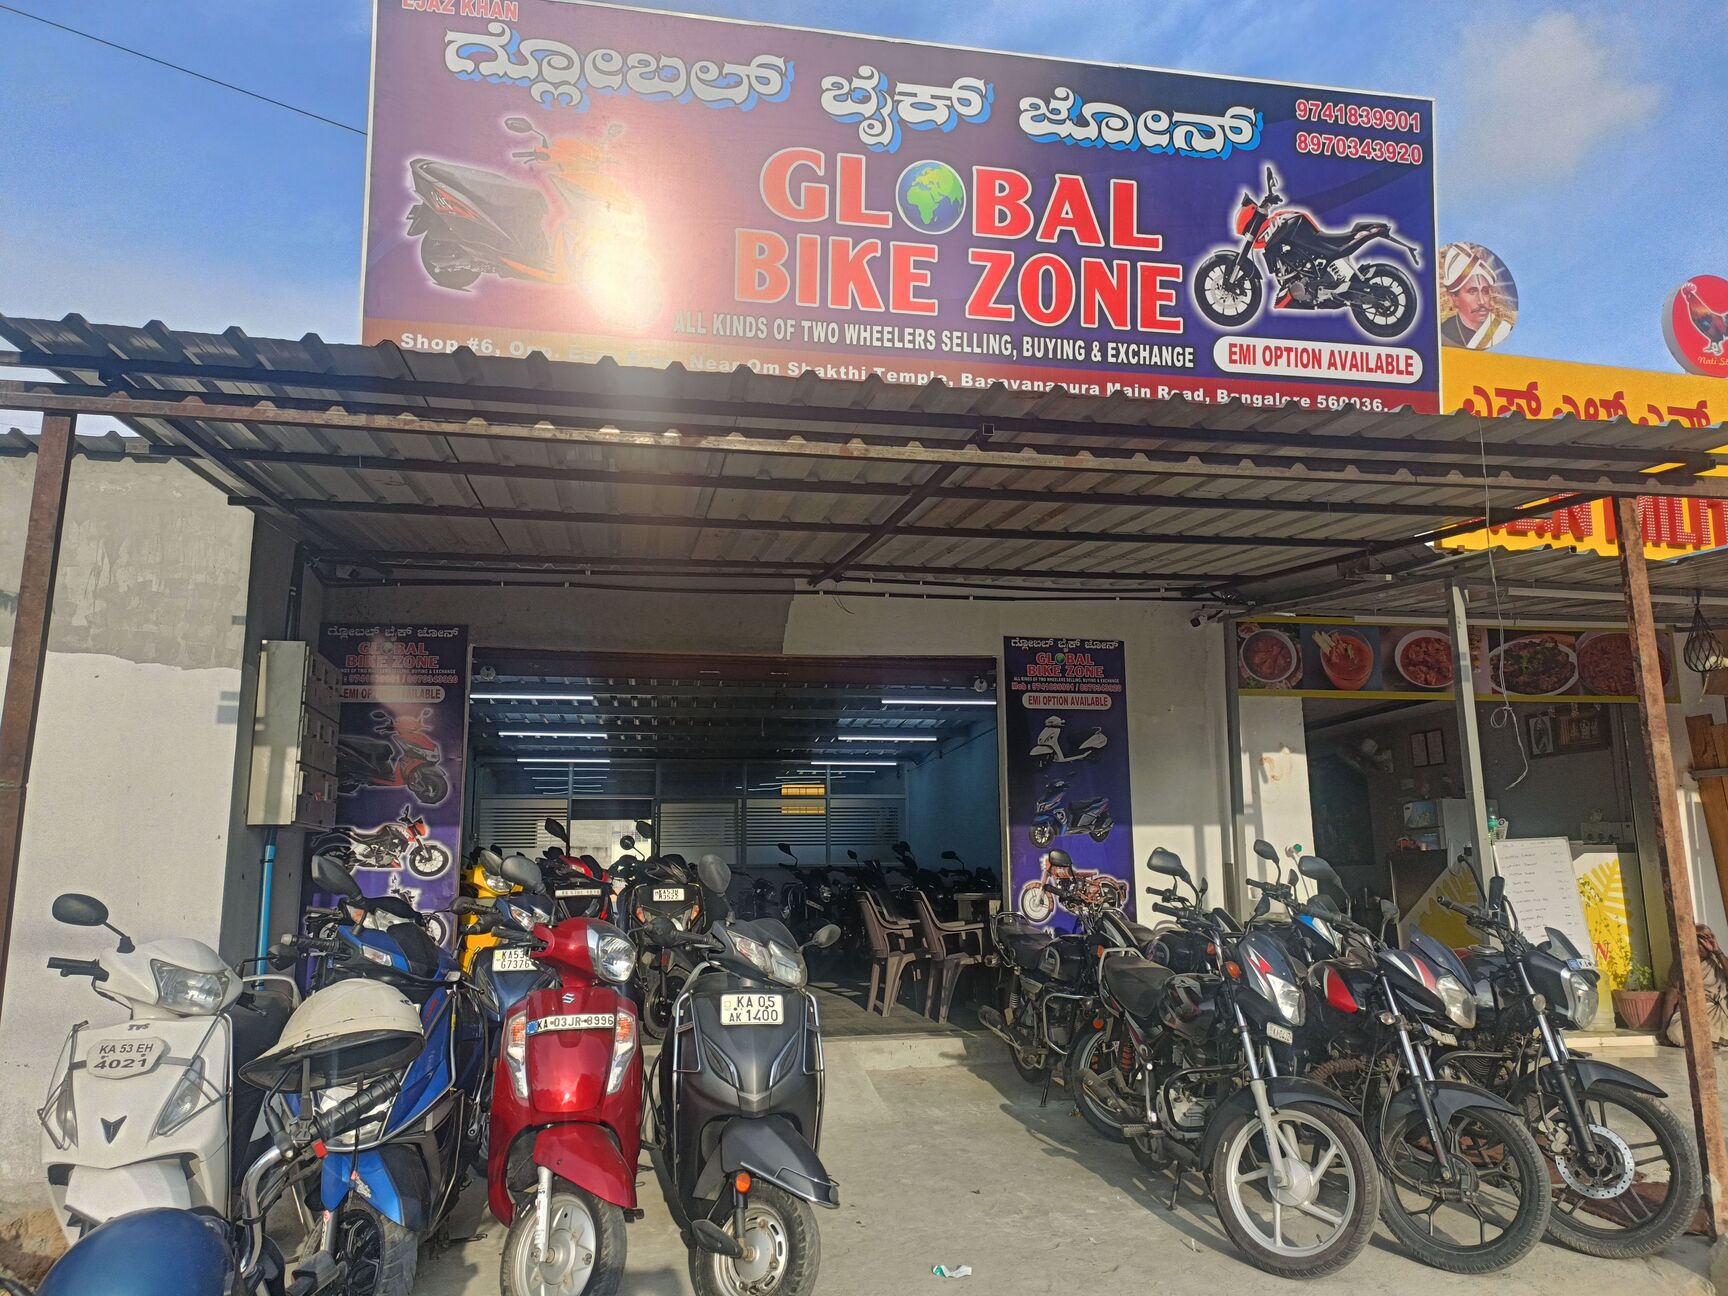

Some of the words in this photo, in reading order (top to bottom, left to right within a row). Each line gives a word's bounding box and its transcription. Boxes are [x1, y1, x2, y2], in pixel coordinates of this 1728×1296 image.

[460, 0, 518, 21] KHAN
[443, 22, 789, 108] ಗ್ಲೋಬಲ್
[820, 64, 988, 147] ಬೈಕ್
[1018, 86, 1258, 155] ಜೋನ್
[1296, 100, 1421, 133] 9741839901
[1296, 133, 1424, 165] 8970343920
[734, 228, 939, 318] BIKE
[965, 245, 1184, 334] ZONE
[673, 311, 706, 335] ALL
[712, 313, 768, 340] KINDS
[773, 318, 796, 340] OF
[801, 320, 839, 344] TWO
[845, 323, 936, 351] WHEELERS
[941, 330, 1017, 360] SELLING,
[1023, 336, 1086, 362] BUYING
[1090, 341, 1103, 362] &
[1107, 342, 1195, 368] EXCHANGE
[1228, 342, 1257, 366] EMI
[1262, 346, 1322, 370] OPTION
[1327, 350, 1415, 376] AVAILABLE
[401, 333, 458, 353] Shop
[1106, 382, 1151, 398] Main
[1217, 389, 1310, 408] Bngalre
[345, 654, 391, 668] BIKE
[391, 655, 440, 669] ZONE
[1026, 664, 1062, 676] BIKE
[1065, 665, 1105, 678] ZONE
[343, 688, 358, 698] EMI
[1028, 695, 1040, 705] EMI
[1042, 696, 1068, 706] OPTION
[1070, 696, 1108, 706] AVAILABLE
[738, 996, 753, 1007] KA
[758, 996, 775, 1007] 05
[729, 1012, 741, 1022] AK
[746, 1009, 778, 1021] 1400
[128, 1023, 150, 1031] TVS
[99, 1044, 116, 1054] KA
[120, 1043, 133, 1053] 53
[136, 1043, 154, 1053] EH
[93, 1057, 147, 1070] 4021
